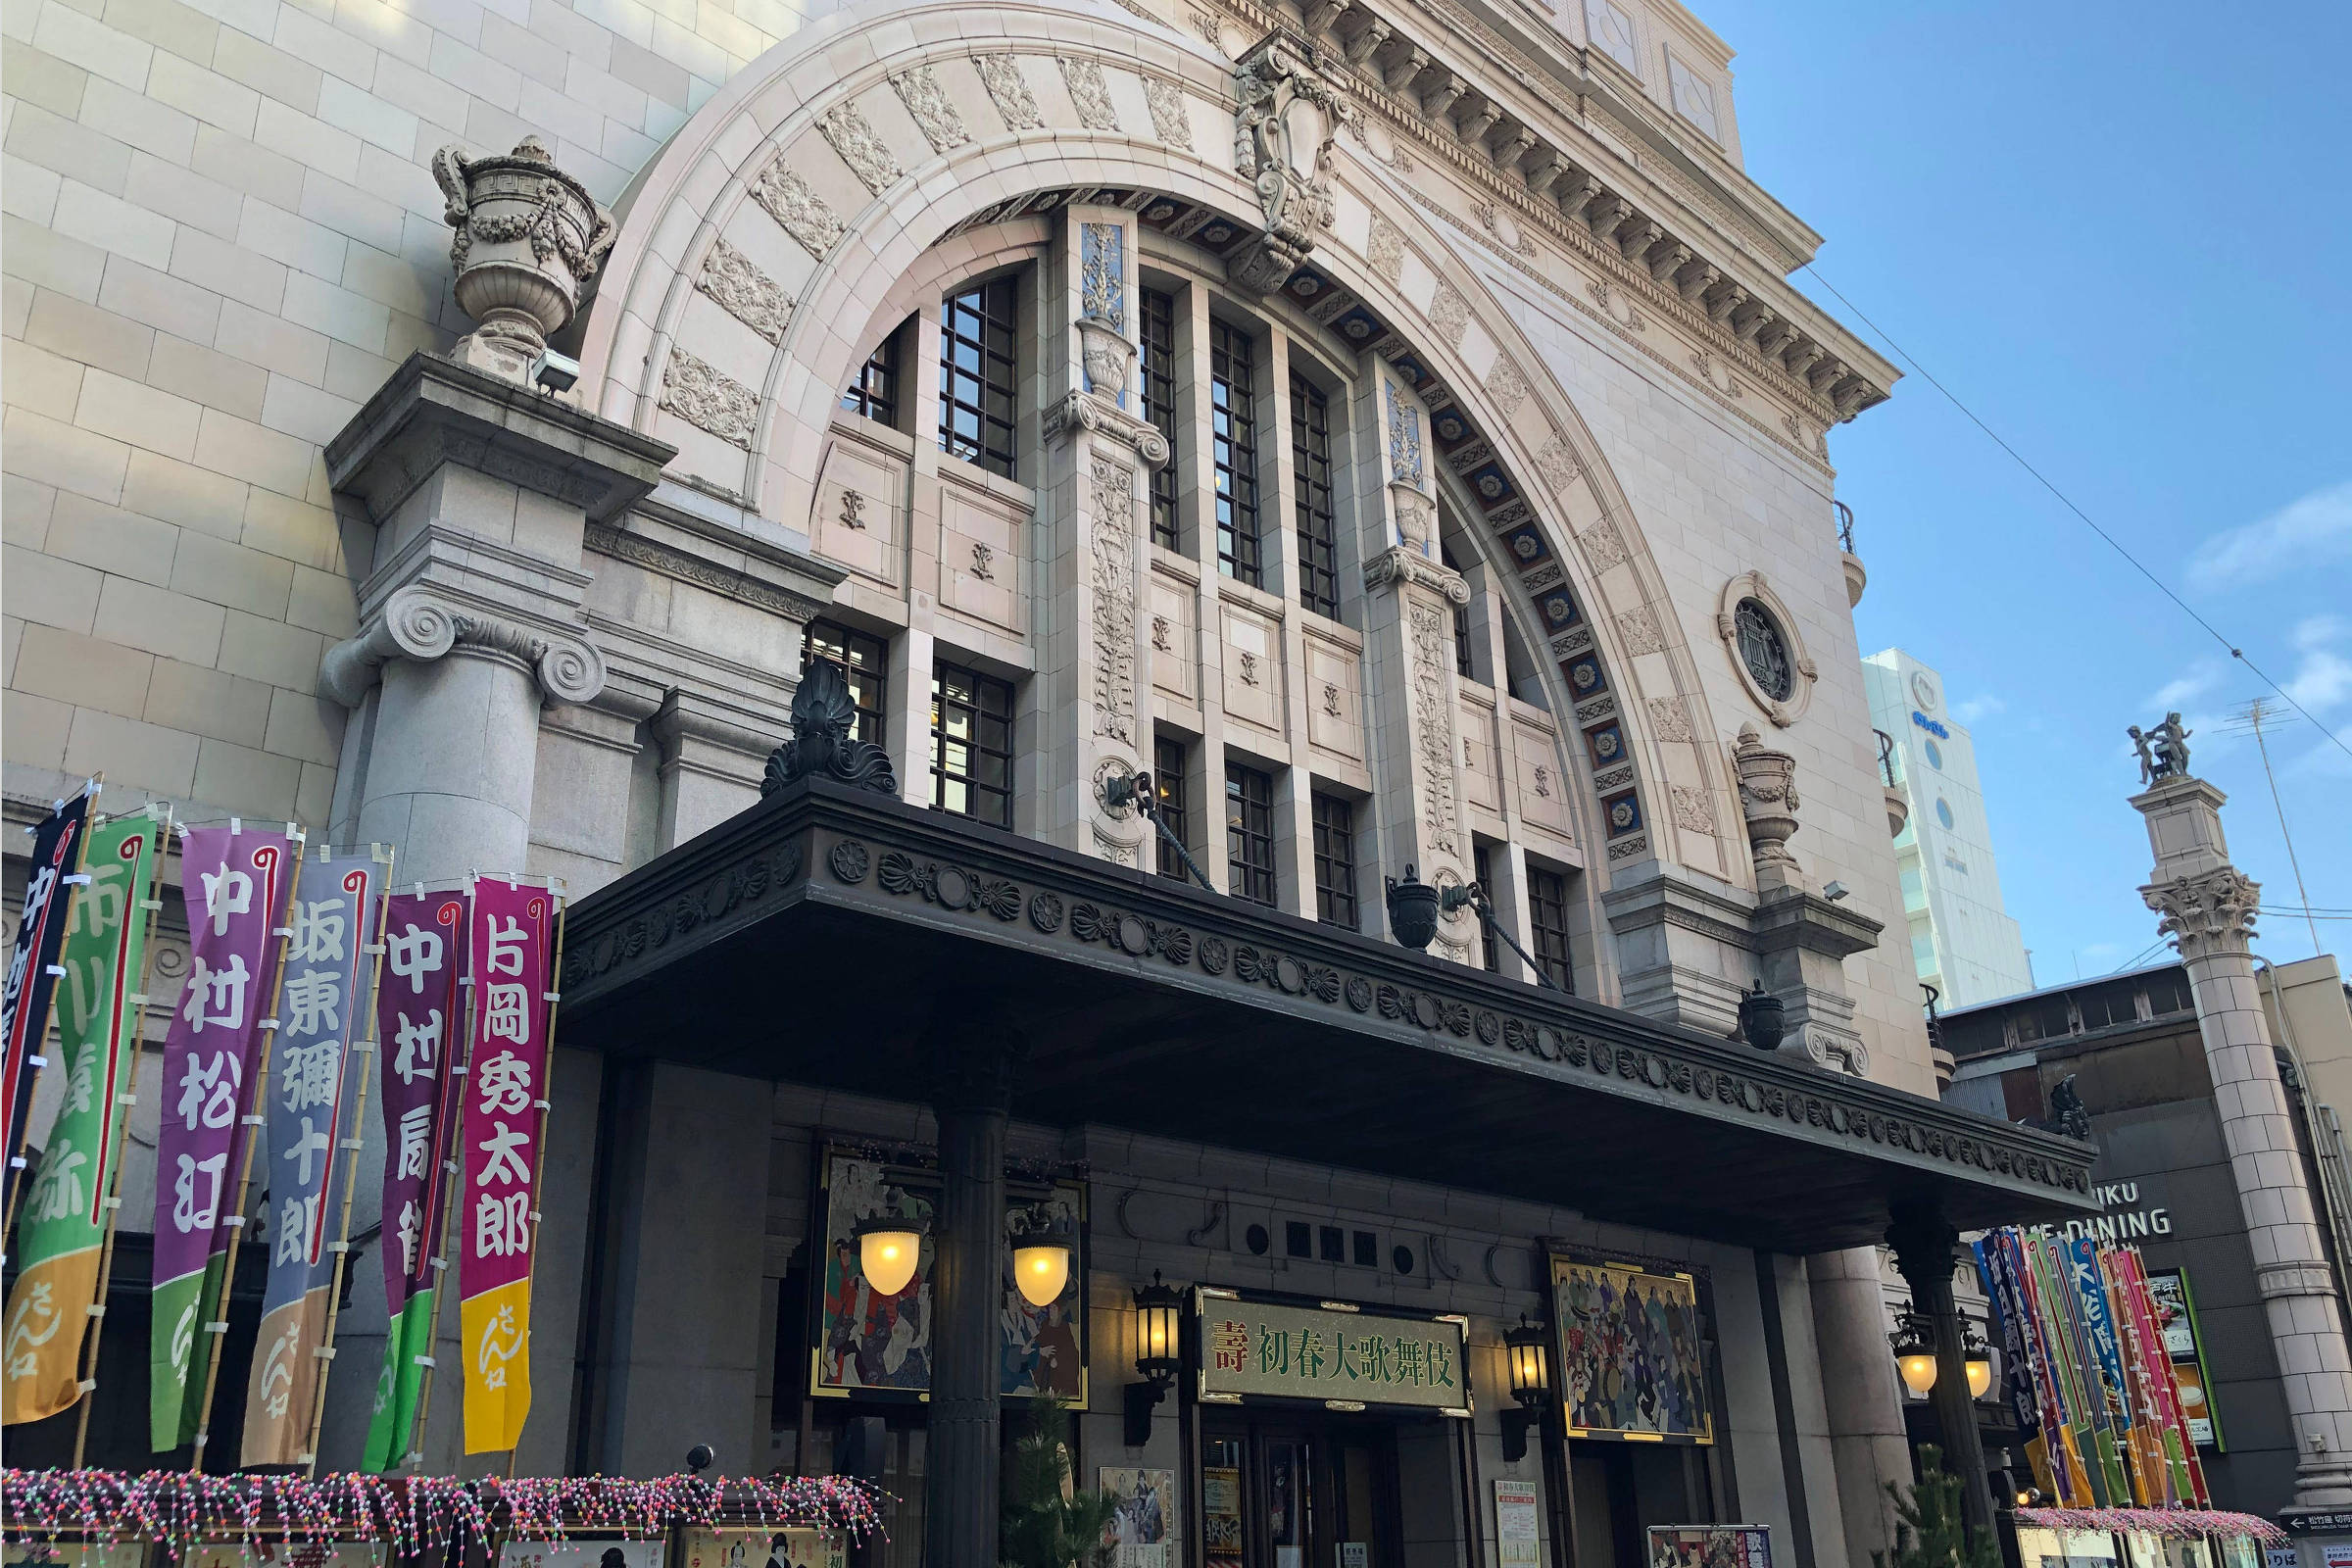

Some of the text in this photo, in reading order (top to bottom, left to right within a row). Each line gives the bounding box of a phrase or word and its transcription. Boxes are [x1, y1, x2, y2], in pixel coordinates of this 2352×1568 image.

[173, 861, 253, 1233] 中村松江
[476, 913, 531, 1259] 片岡秀太郎
[2066, 1208, 2172, 1242] DINING
